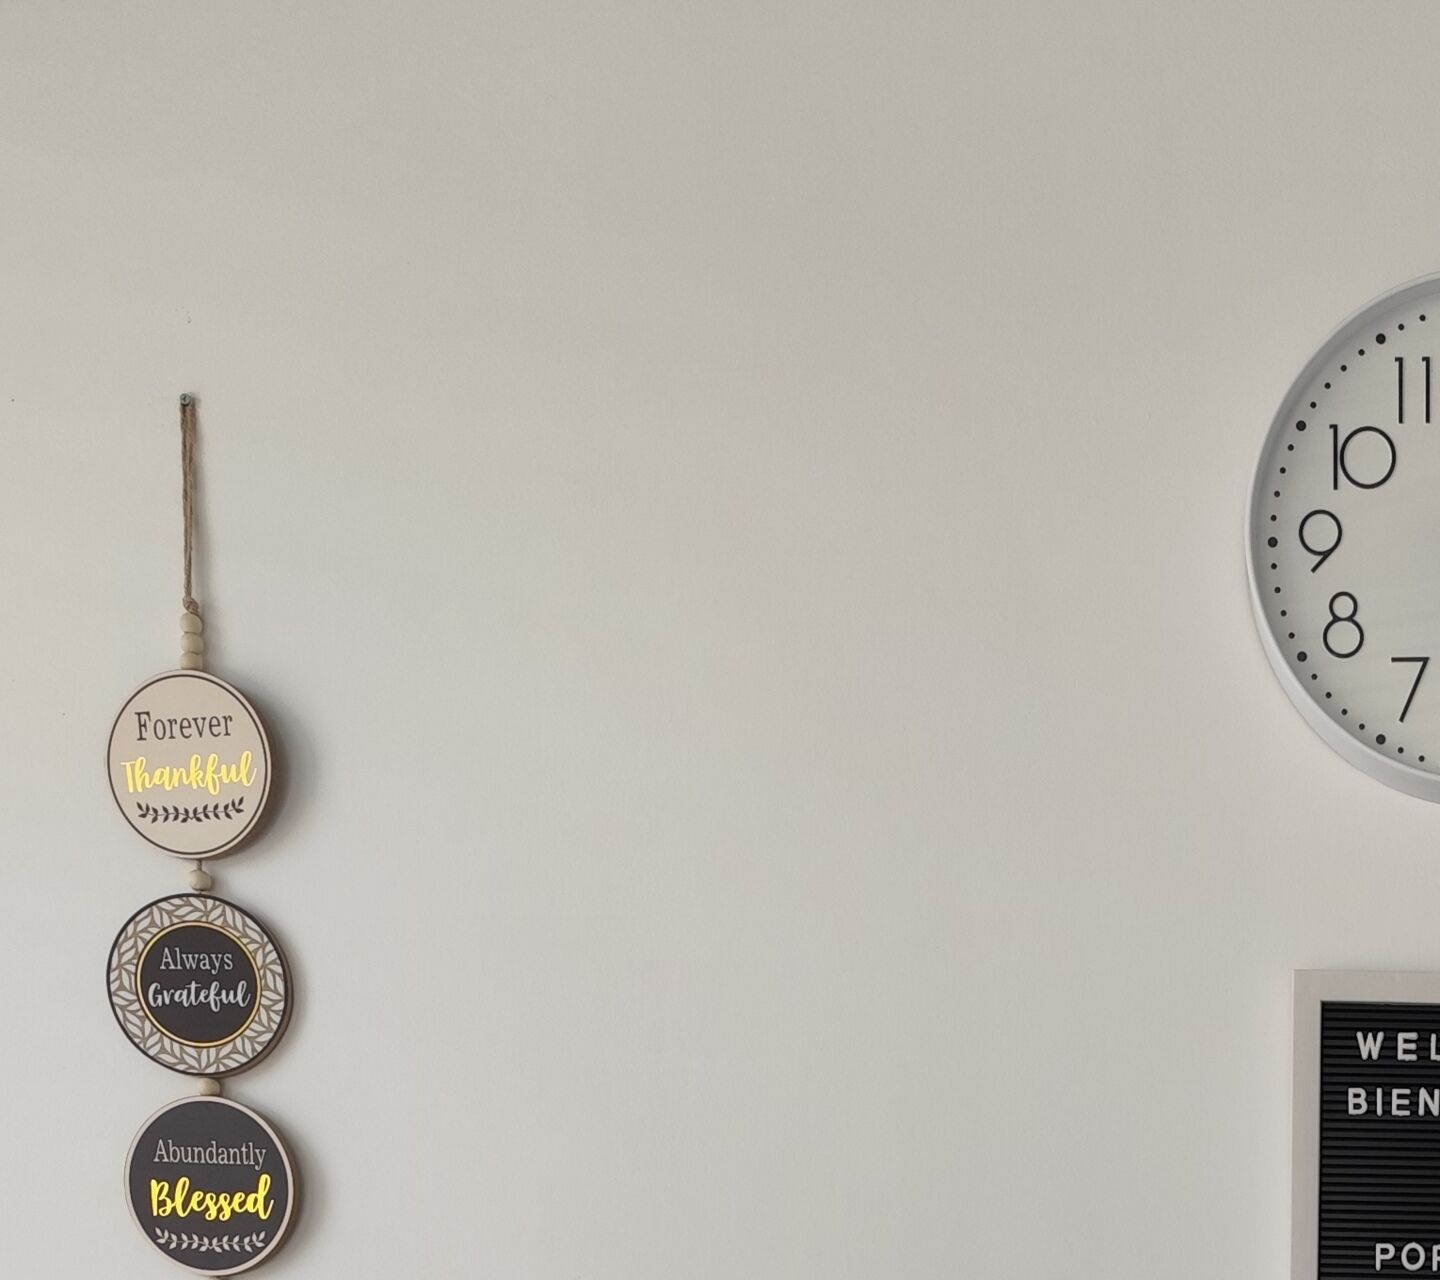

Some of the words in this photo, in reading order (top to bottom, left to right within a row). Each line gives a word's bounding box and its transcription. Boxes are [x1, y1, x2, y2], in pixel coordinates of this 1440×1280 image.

[1394, 356, 1431, 424] 11
[1328, 423, 1397, 490] 10
[1298, 509, 1343, 573] 9
[1322, 591, 1365, 659] 8
[1390, 656, 1430, 723] 7
[134, 711, 233, 741] Forever
[120, 750, 258, 796] Thankful
[159, 947, 234, 975] Always
[148, 979, 252, 1013] Grateful
[152, 1139, 268, 1171] Abundantly
[149, 1173, 275, 1222] Blessed
